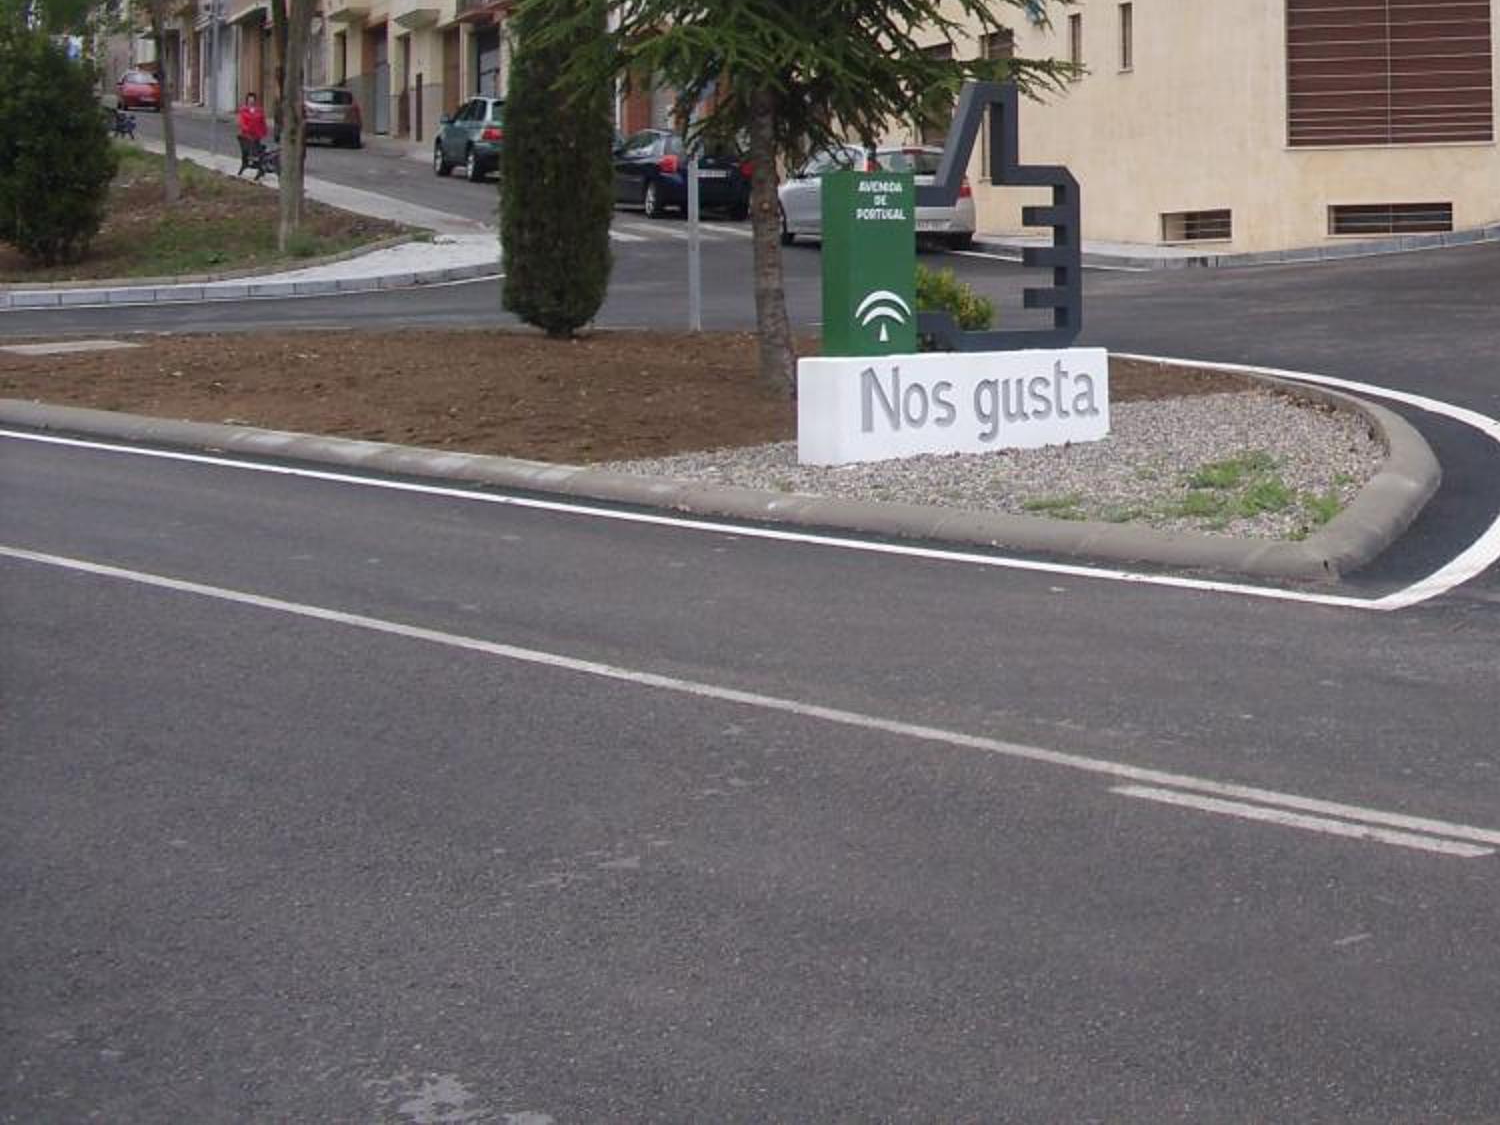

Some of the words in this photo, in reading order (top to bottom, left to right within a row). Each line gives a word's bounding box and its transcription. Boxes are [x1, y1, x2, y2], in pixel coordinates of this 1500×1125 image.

[858, 180, 903, 192] AVENIDA
[873, 194, 888, 206] DE
[856, 208, 907, 220] PORTUGAL
[860, 365, 957, 433] Nos
[973, 359, 1099, 442] gusta
